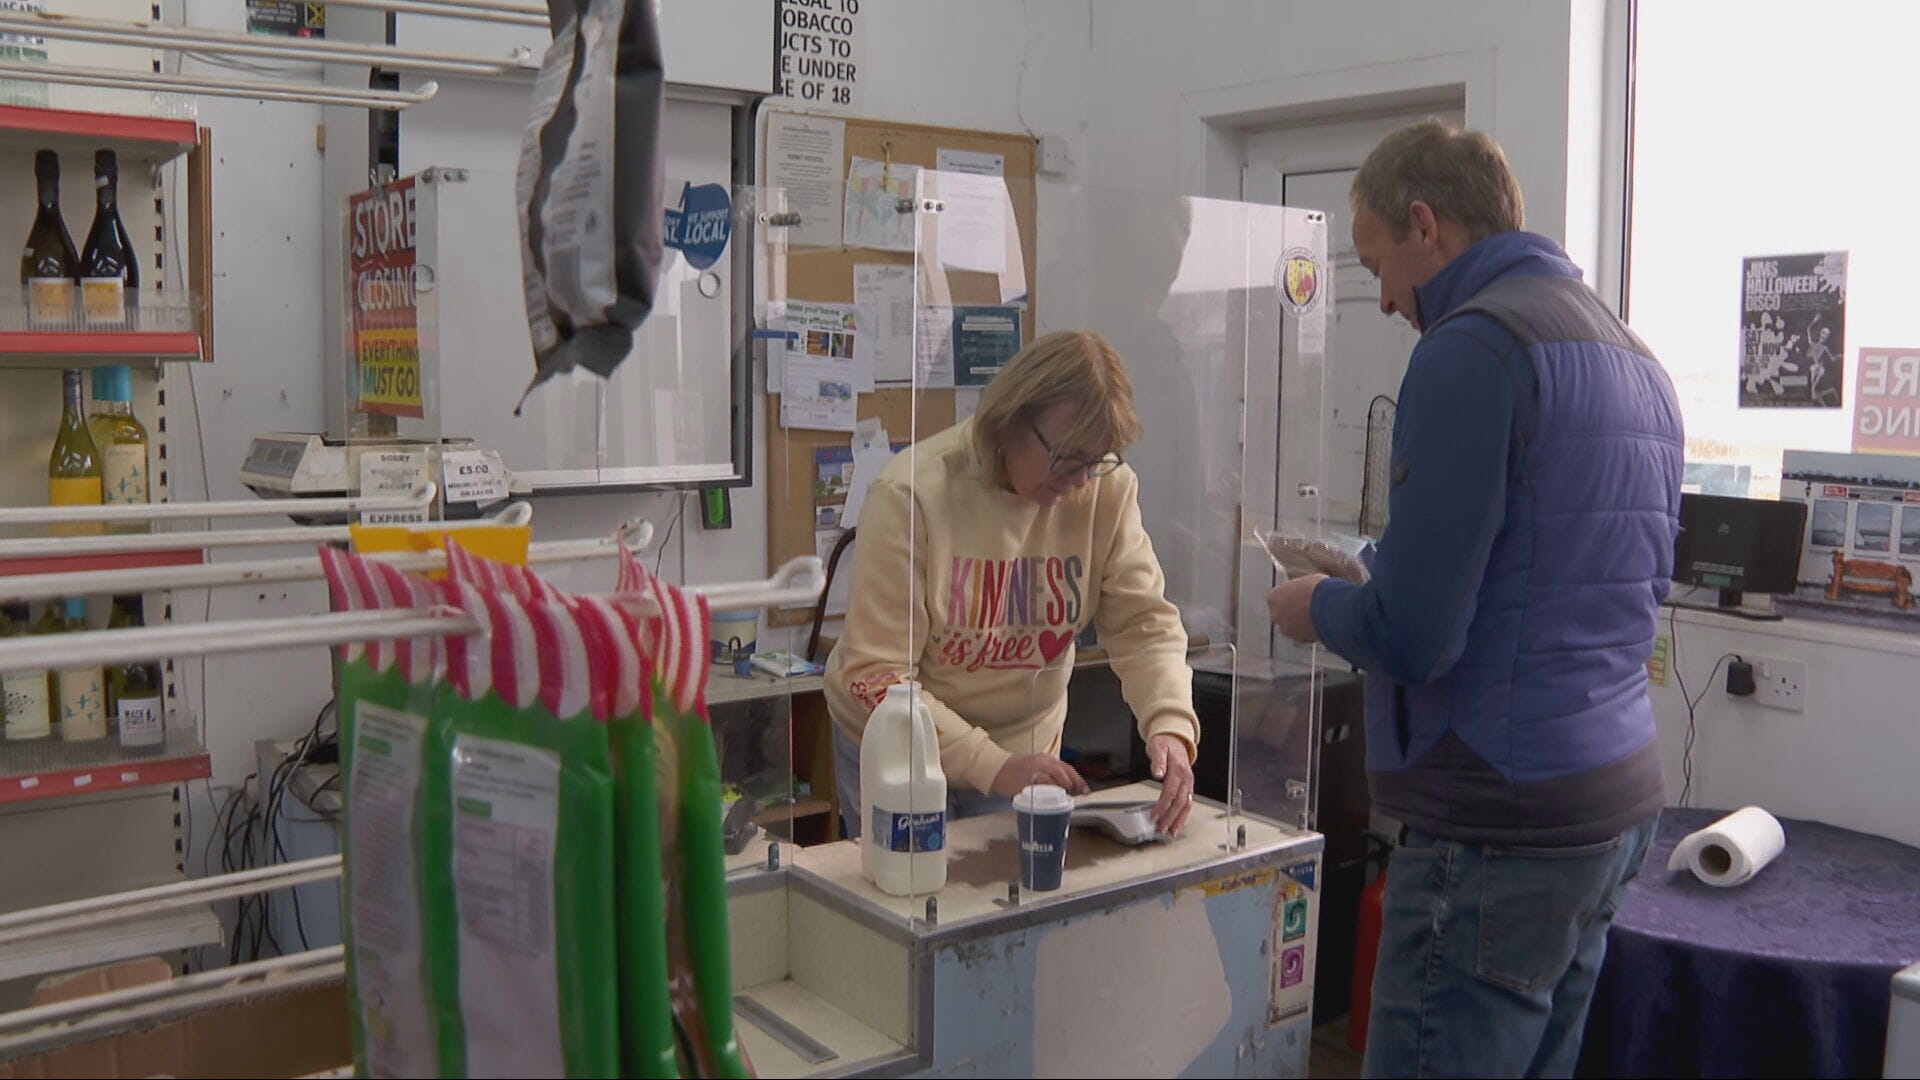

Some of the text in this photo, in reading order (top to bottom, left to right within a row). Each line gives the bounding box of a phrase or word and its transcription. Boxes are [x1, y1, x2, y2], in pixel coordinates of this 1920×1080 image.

[782, 9, 853, 36] OBACCO
[829, 38, 851, 58] TO
[799, 57, 856, 83] UNDER
[781, 79, 851, 105] E OF 18
[356, 187, 416, 258] STORE
[683, 220, 727, 245] LOCAL
[1745, 275, 1819, 295] HALLOWEEN
[1745, 294, 1781, 312] DISCO
[362, 365, 394, 396] MUST
[381, 454, 411, 462] SORRY
[459, 464, 489, 476] £5.00
[369, 512, 424, 524] EXPRESS
[942, 630, 1036, 673] is free
